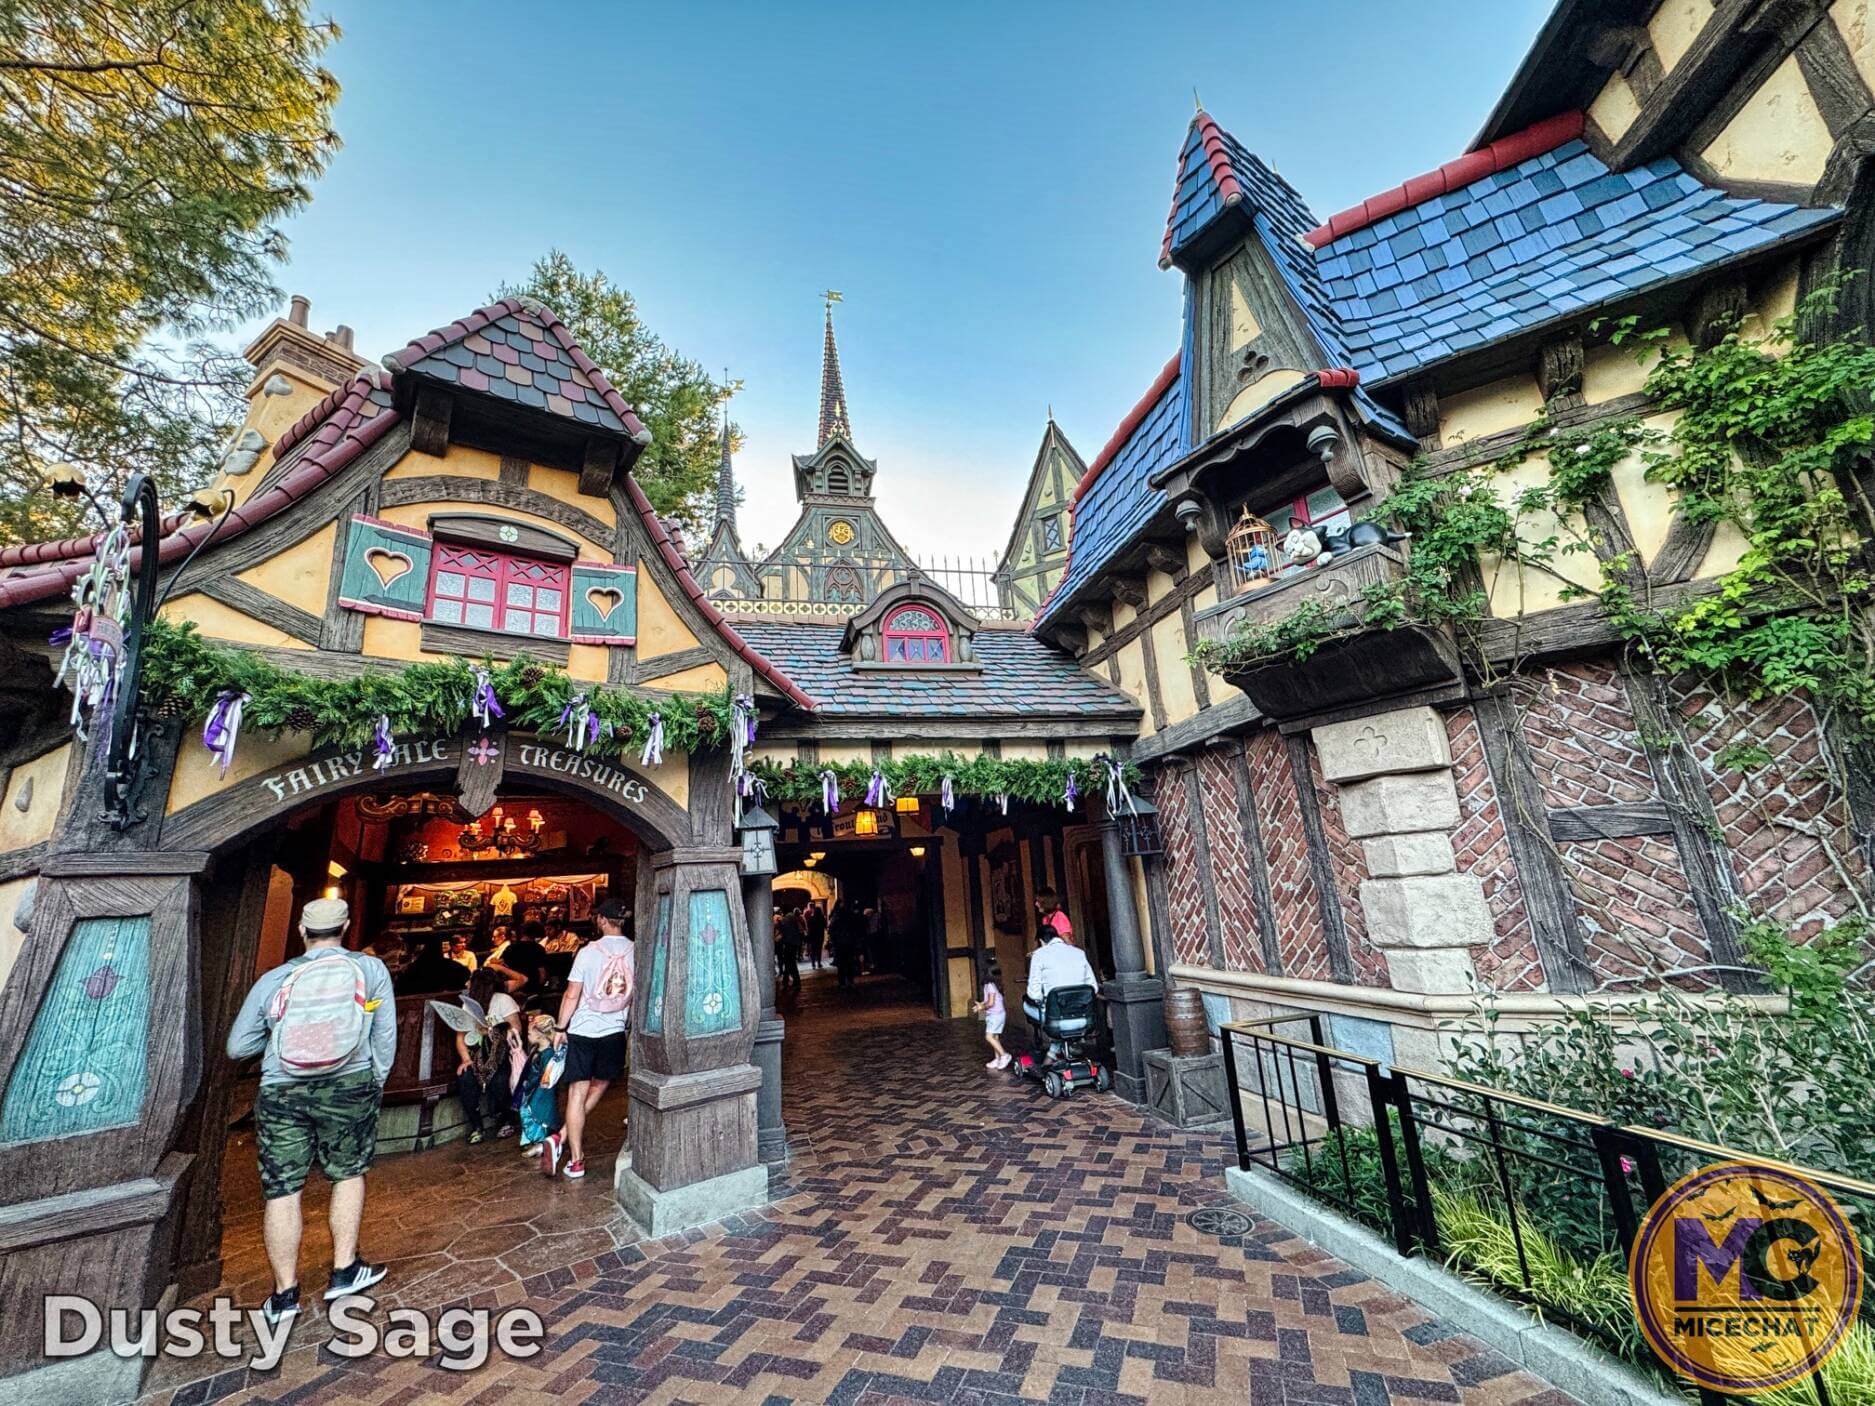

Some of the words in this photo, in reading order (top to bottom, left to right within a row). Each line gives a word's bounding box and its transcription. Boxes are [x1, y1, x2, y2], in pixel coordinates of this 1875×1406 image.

[260, 752, 363, 802] FAIRY
[372, 739, 449, 768] ALE
[519, 744, 649, 804] TREASURES
